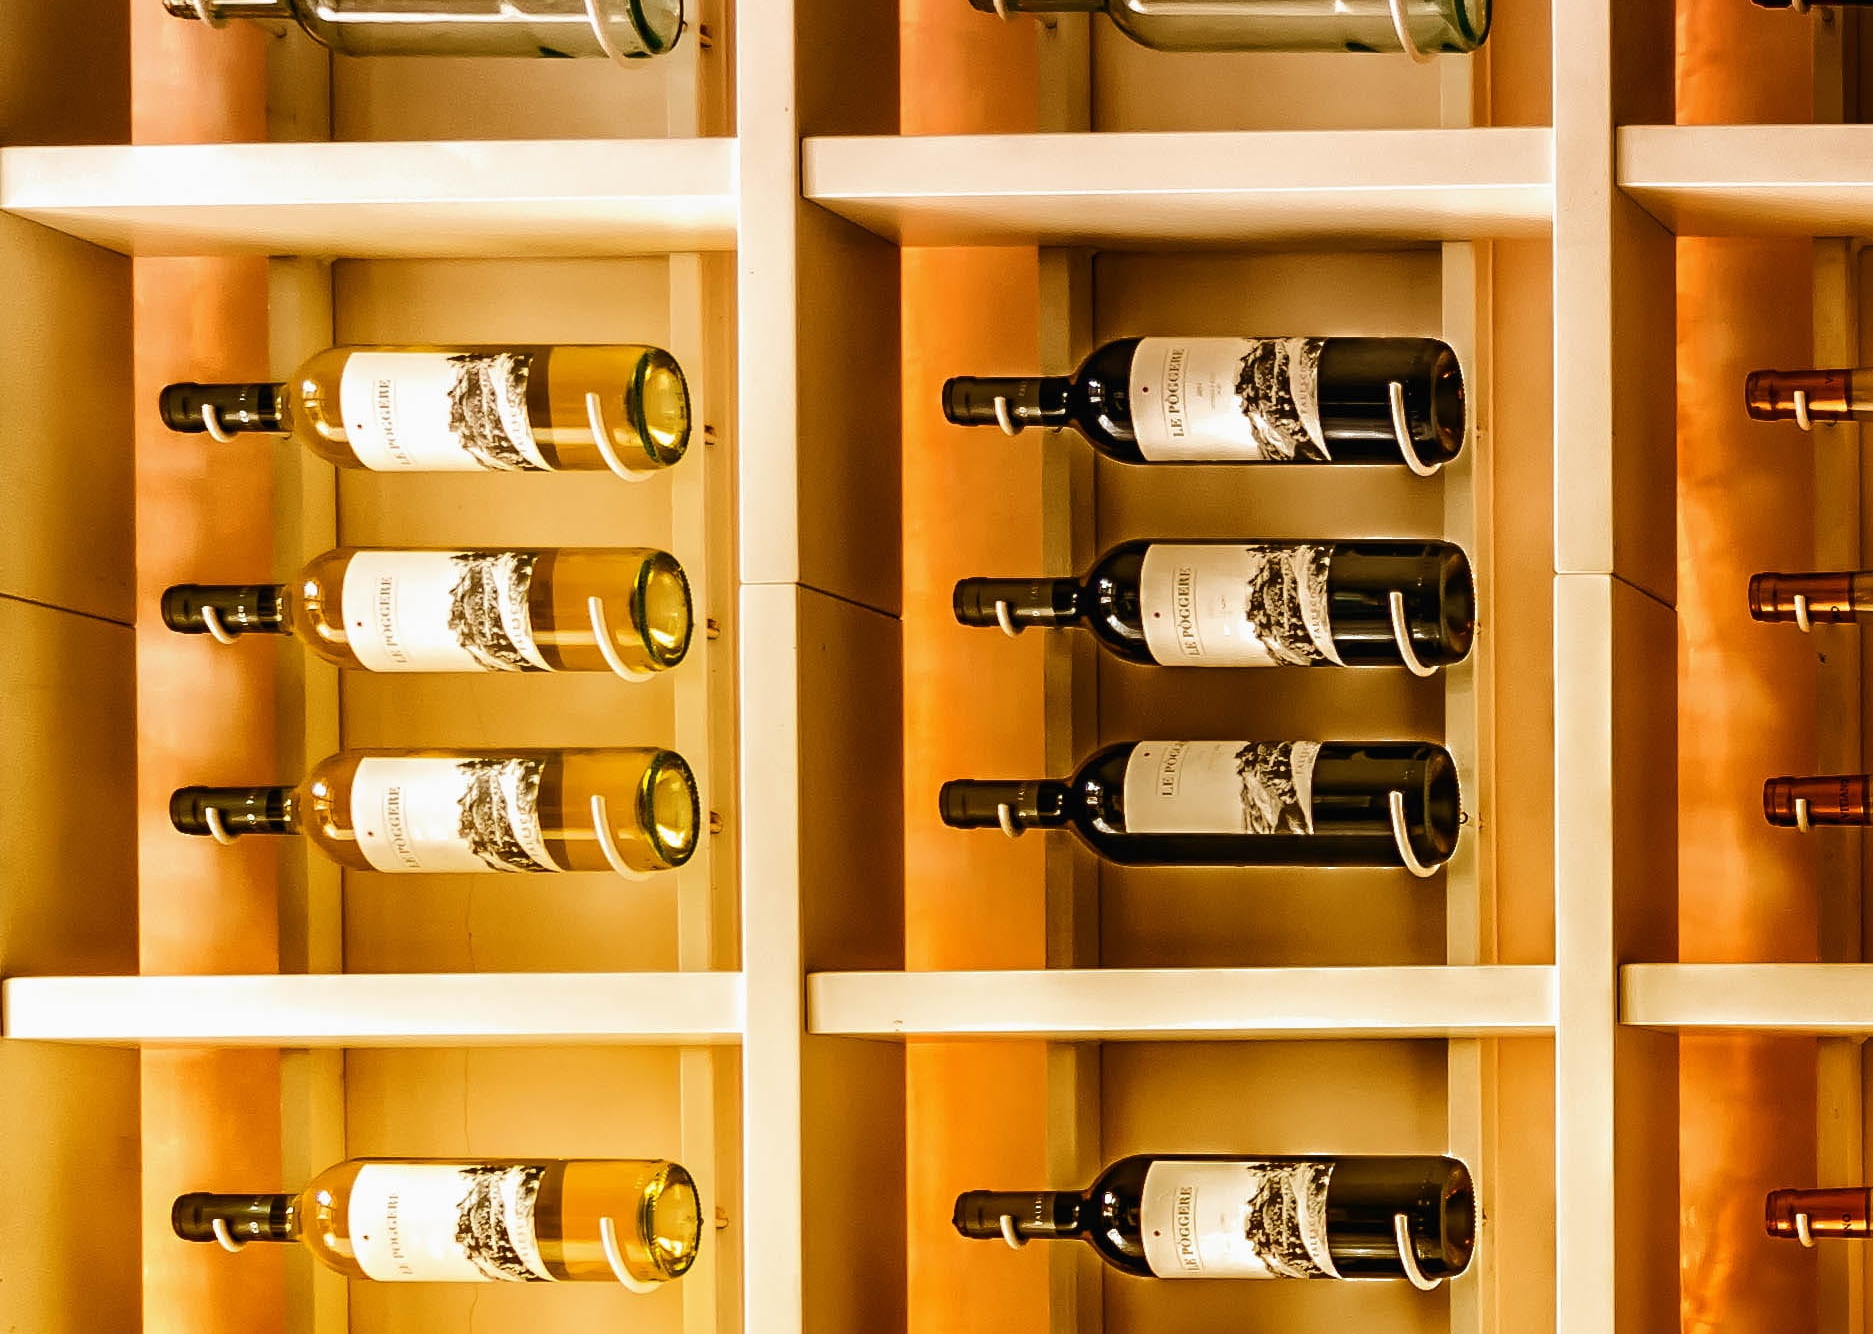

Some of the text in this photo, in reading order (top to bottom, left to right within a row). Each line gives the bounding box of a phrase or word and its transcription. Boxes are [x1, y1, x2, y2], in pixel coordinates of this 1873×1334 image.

[1171, 419, 1186, 437] LE
[1184, 641, 1201, 657] LE
[1162, 777, 1174, 797] LE
[1186, 1259, 1201, 1271] LE
